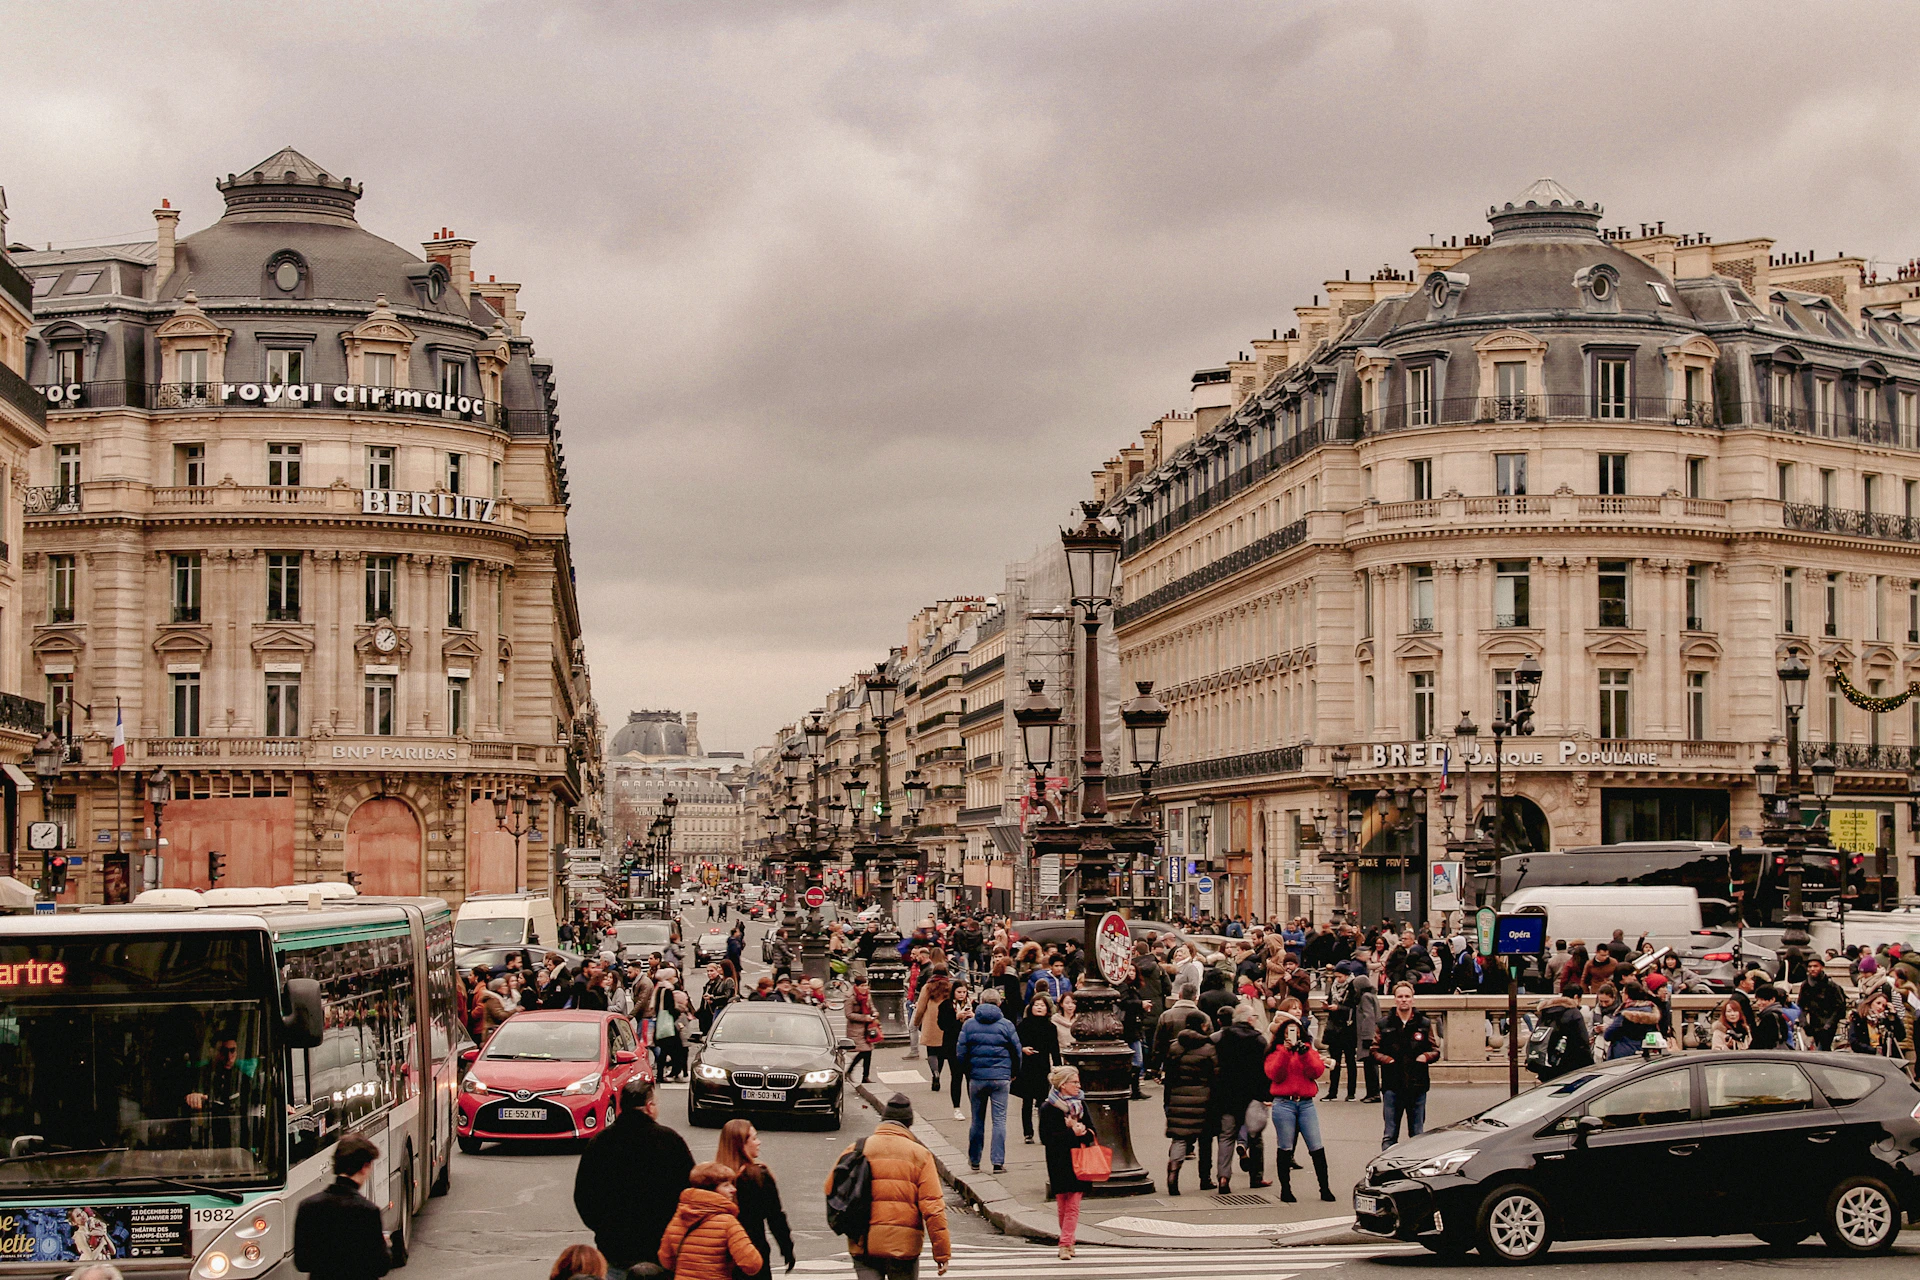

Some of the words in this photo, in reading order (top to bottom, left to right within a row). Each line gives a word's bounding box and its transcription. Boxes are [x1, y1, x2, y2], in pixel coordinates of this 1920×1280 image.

[220, 383, 322, 403] royal
[333, 384, 386, 404] air
[394, 388, 484, 416] maroc
[362, 489, 498, 523] BERLITZ
[332, 746, 375, 760] BNP
[380, 746, 457, 761] PARIBAS
[1372, 742, 1451, 767] BRED
[1385, 858, 1410, 867] PRIVE
[1508, 930, 1531, 939] Opéra
[0, 958, 65, 985] artre
[504, 1109, 541, 1119] EE-552-KY
[139, 1207, 170, 1215] DÉCEMBRE
[194, 1209, 234, 1222] 1982
